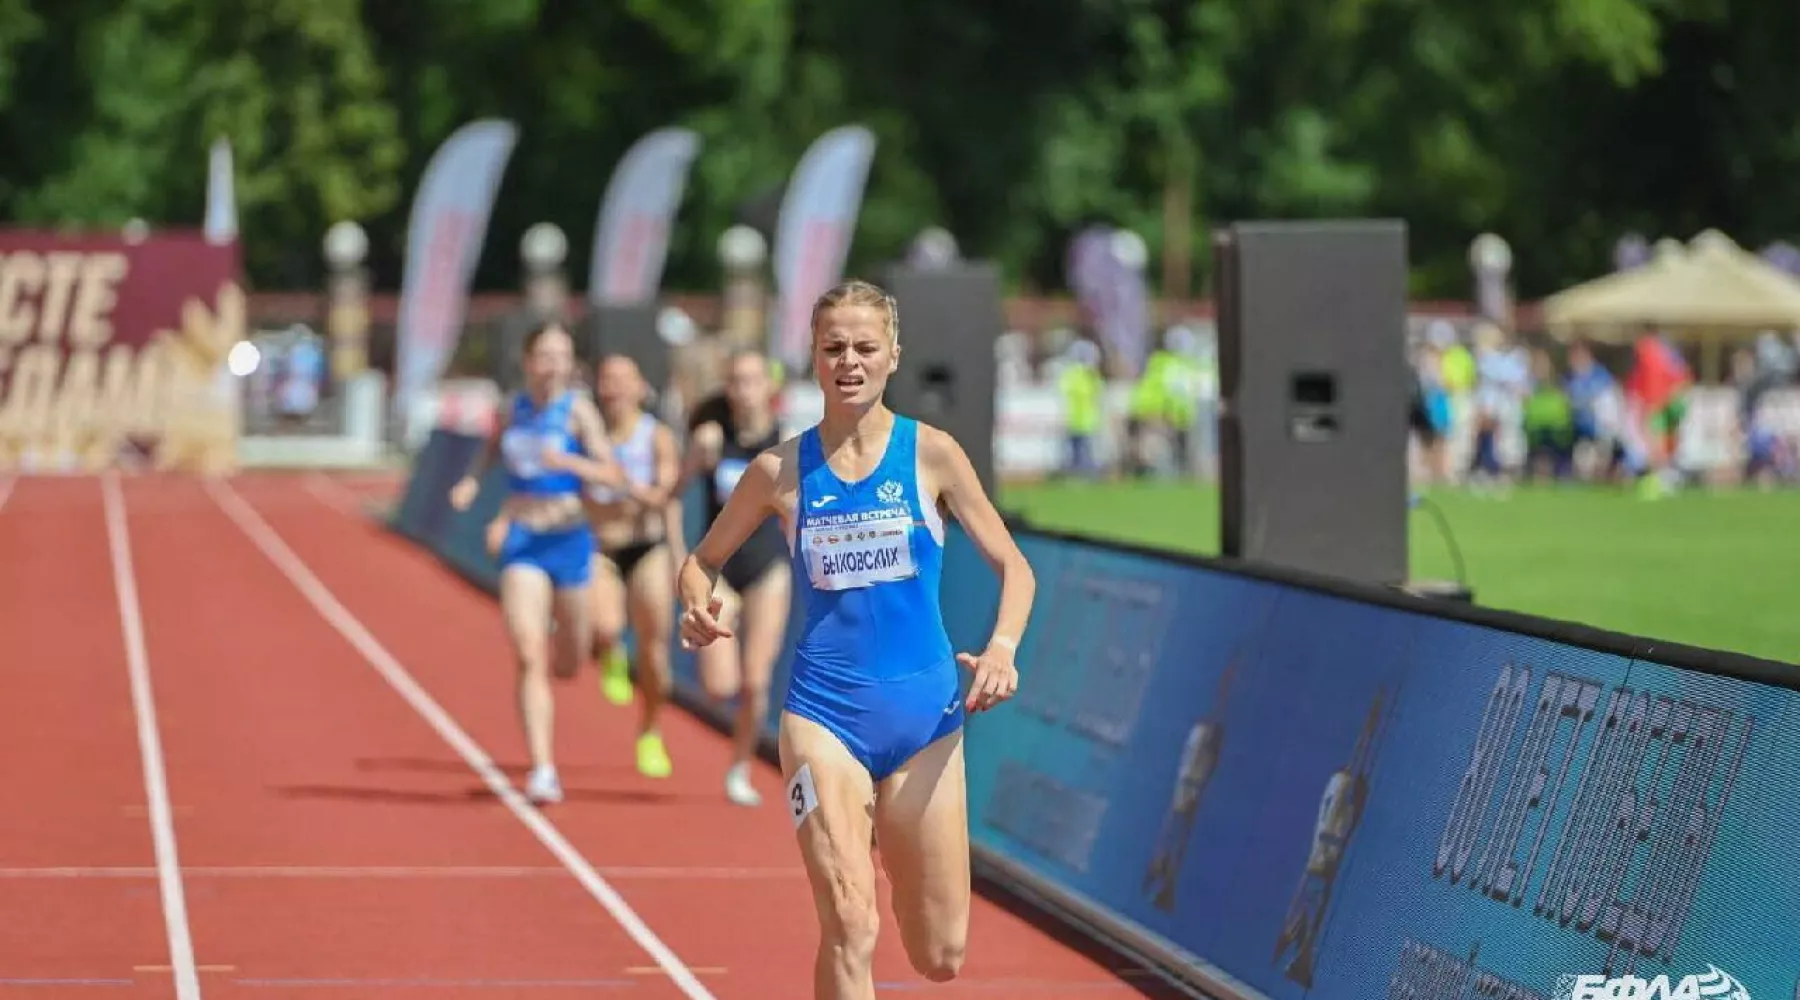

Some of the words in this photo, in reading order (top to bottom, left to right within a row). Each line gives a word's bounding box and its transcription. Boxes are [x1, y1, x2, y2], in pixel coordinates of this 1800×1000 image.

[806, 513, 859, 526] МАТЧЕВАЯ
[861, 507, 905, 521] ВСТРЕЧА
[822, 547, 899, 576] БЫКОВСКИХ
[791, 783, 805, 816] 3
[1432, 664, 1532, 883] 80
[1469, 672, 1602, 908] ЛЕТ
[1533, 687, 1756, 977] ПОБЕДЫ
